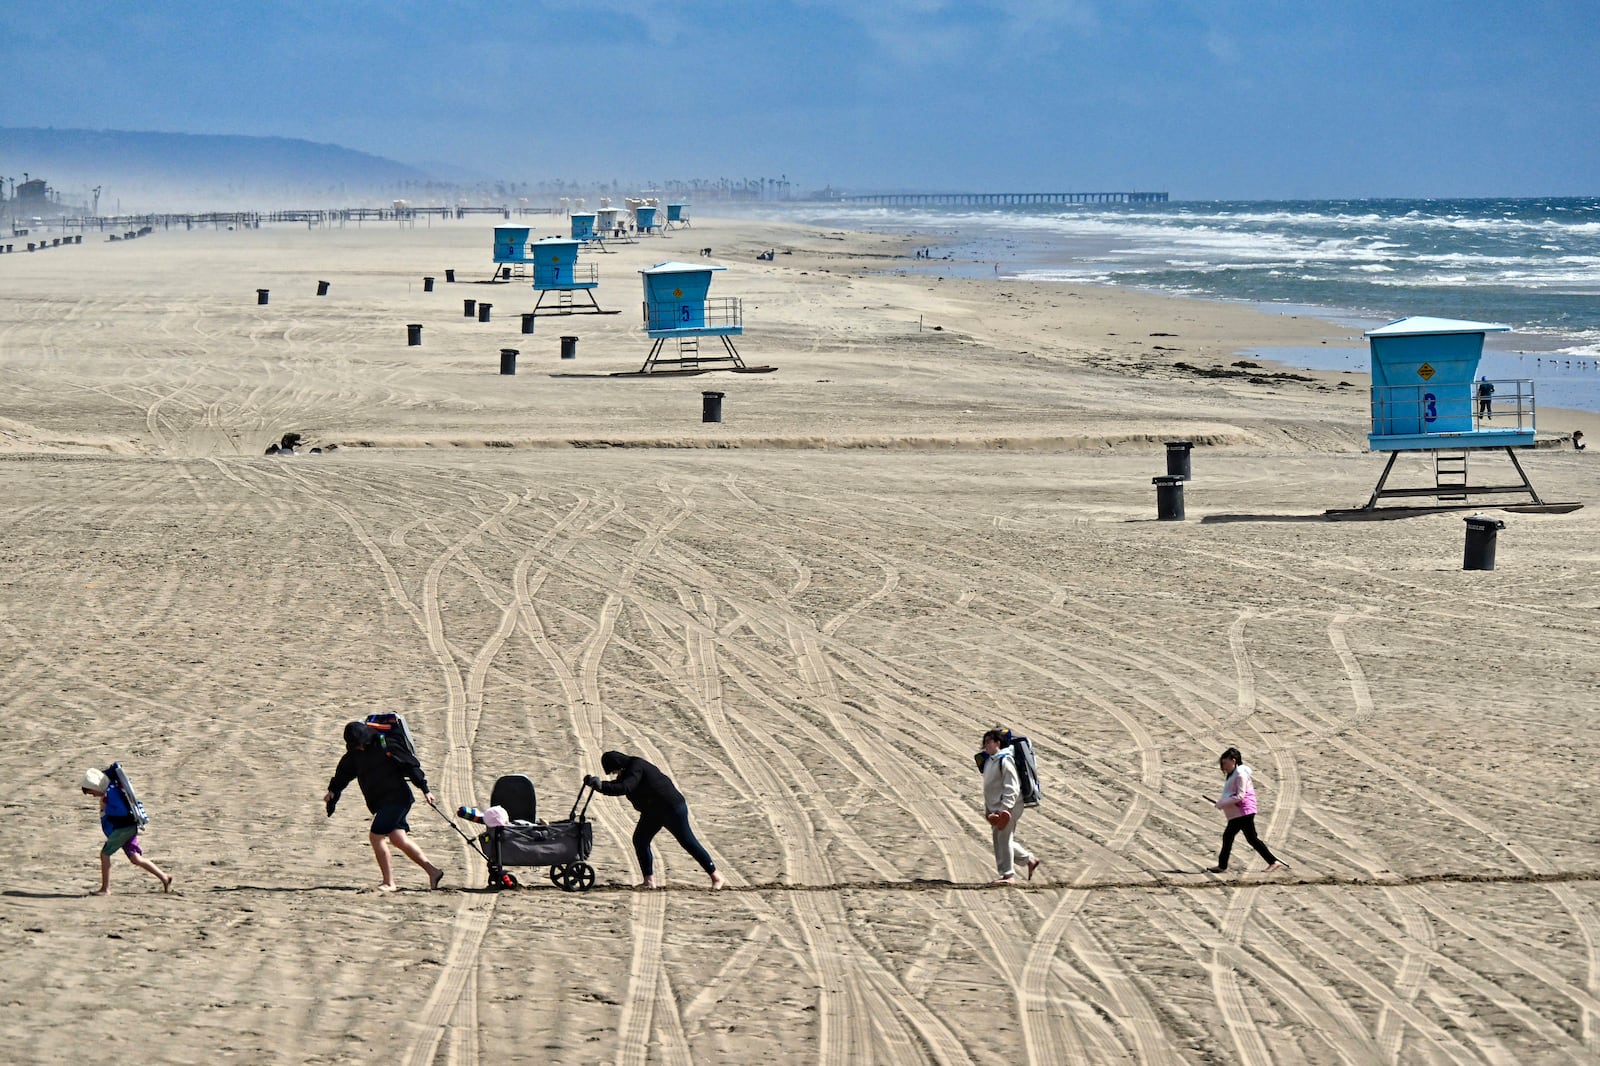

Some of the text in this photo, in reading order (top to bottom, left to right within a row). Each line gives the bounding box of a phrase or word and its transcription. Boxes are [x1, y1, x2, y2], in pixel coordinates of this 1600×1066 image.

[554, 267, 560, 279] 7
[681, 305, 690, 321] 5
[1424, 393, 1437, 422] 3
